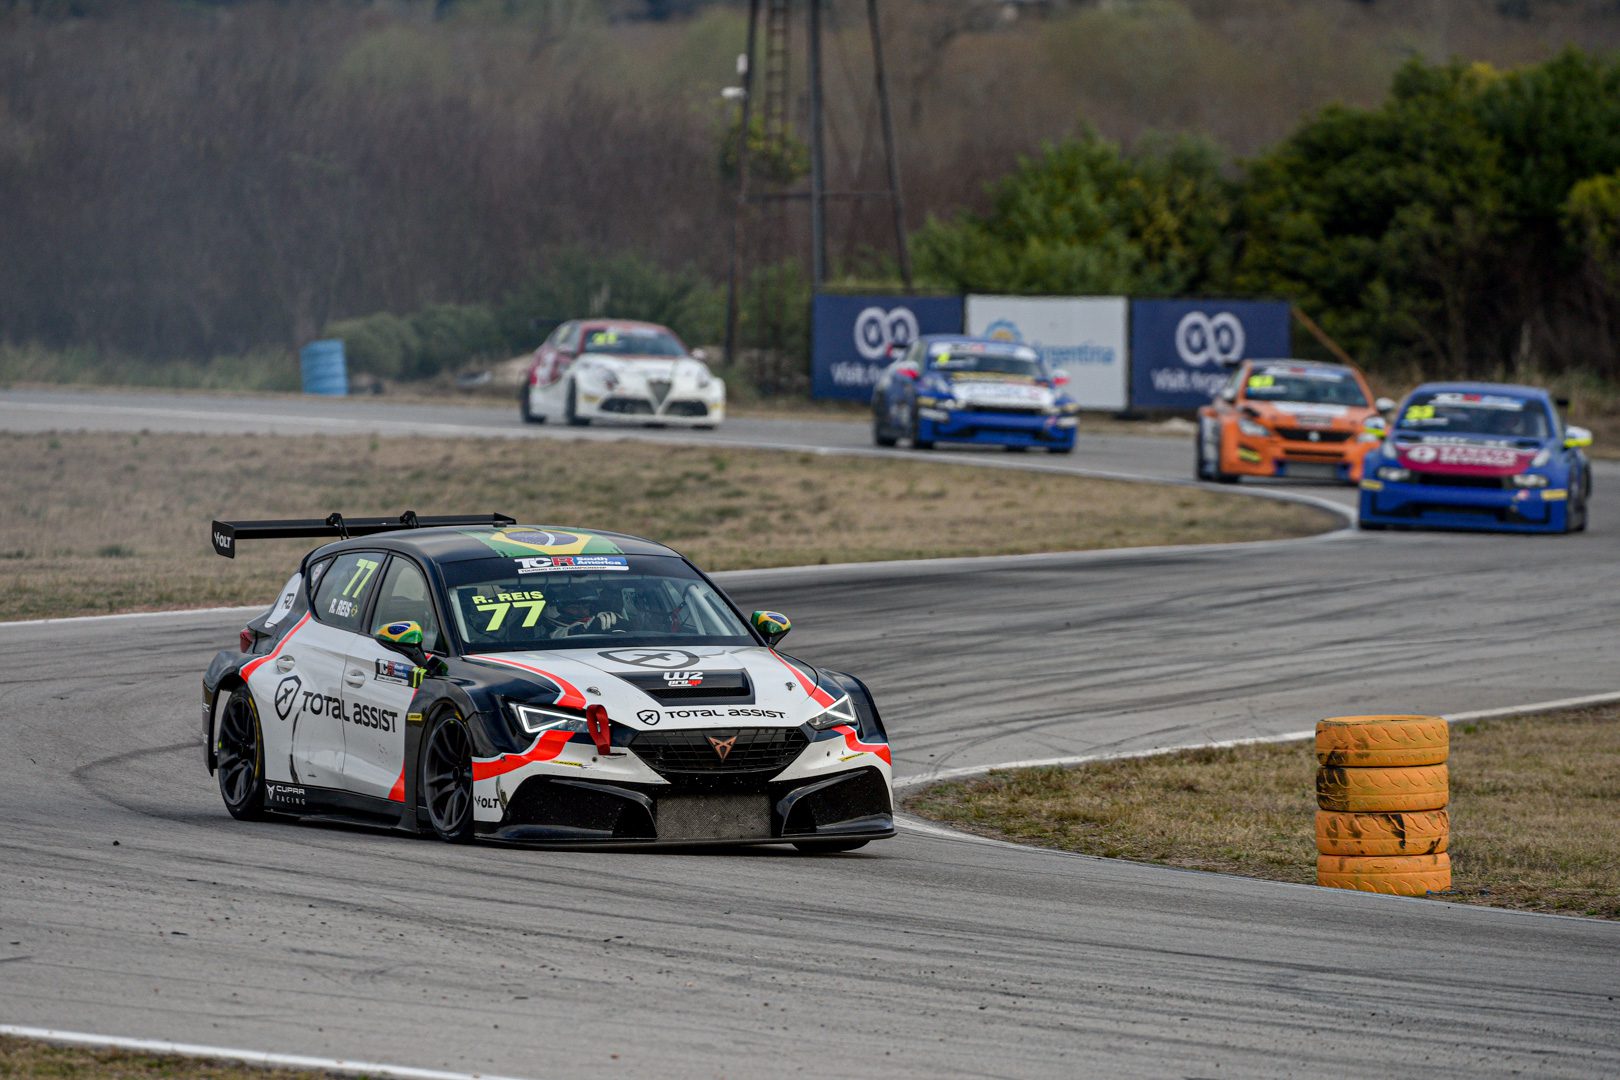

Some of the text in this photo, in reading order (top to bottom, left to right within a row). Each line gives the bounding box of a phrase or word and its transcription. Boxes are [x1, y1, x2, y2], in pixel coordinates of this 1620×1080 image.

[514, 556, 576, 569] TCR
[342, 558, 379, 599] 77
[472, 590, 544, 605] R. REIS
[335, 599, 353, 618] REIS
[476, 599, 547, 632] 77
[663, 671, 704, 681] W2
[276, 785, 306, 796] CUPRA
[276, 794, 306, 806] RACING
[474, 795, 500, 809] VOLT
